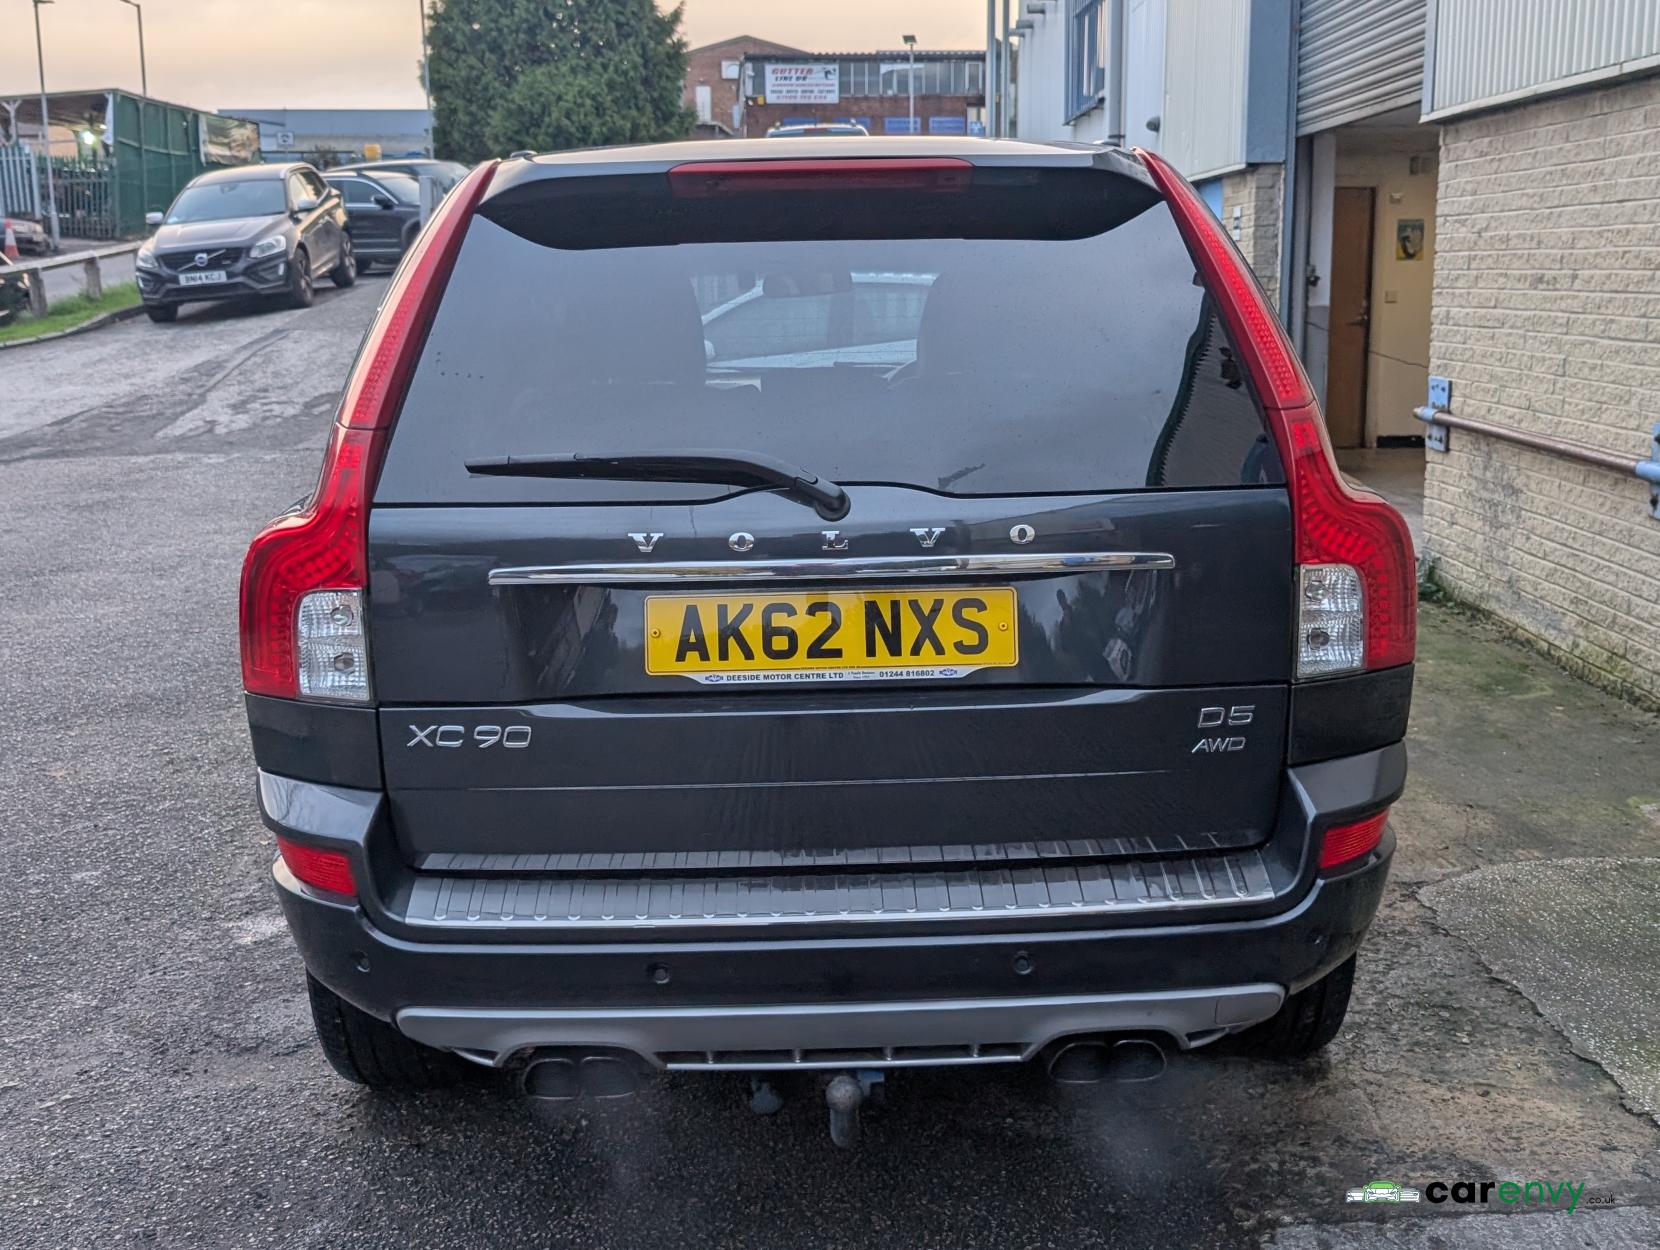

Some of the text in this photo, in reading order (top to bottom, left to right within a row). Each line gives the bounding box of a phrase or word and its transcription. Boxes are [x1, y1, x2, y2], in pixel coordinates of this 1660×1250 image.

[627, 524, 1036, 553] VOLVO
[675, 597, 989, 662] AK62 NXS
[794, 672, 826, 680] CENTRE
[879, 670, 904, 678] 01244
[905, 669, 935, 677] 816802
[1198, 704, 1256, 728] D5
[406, 724, 532, 748] XC 90
[1191, 736, 1246, 753] AWD
